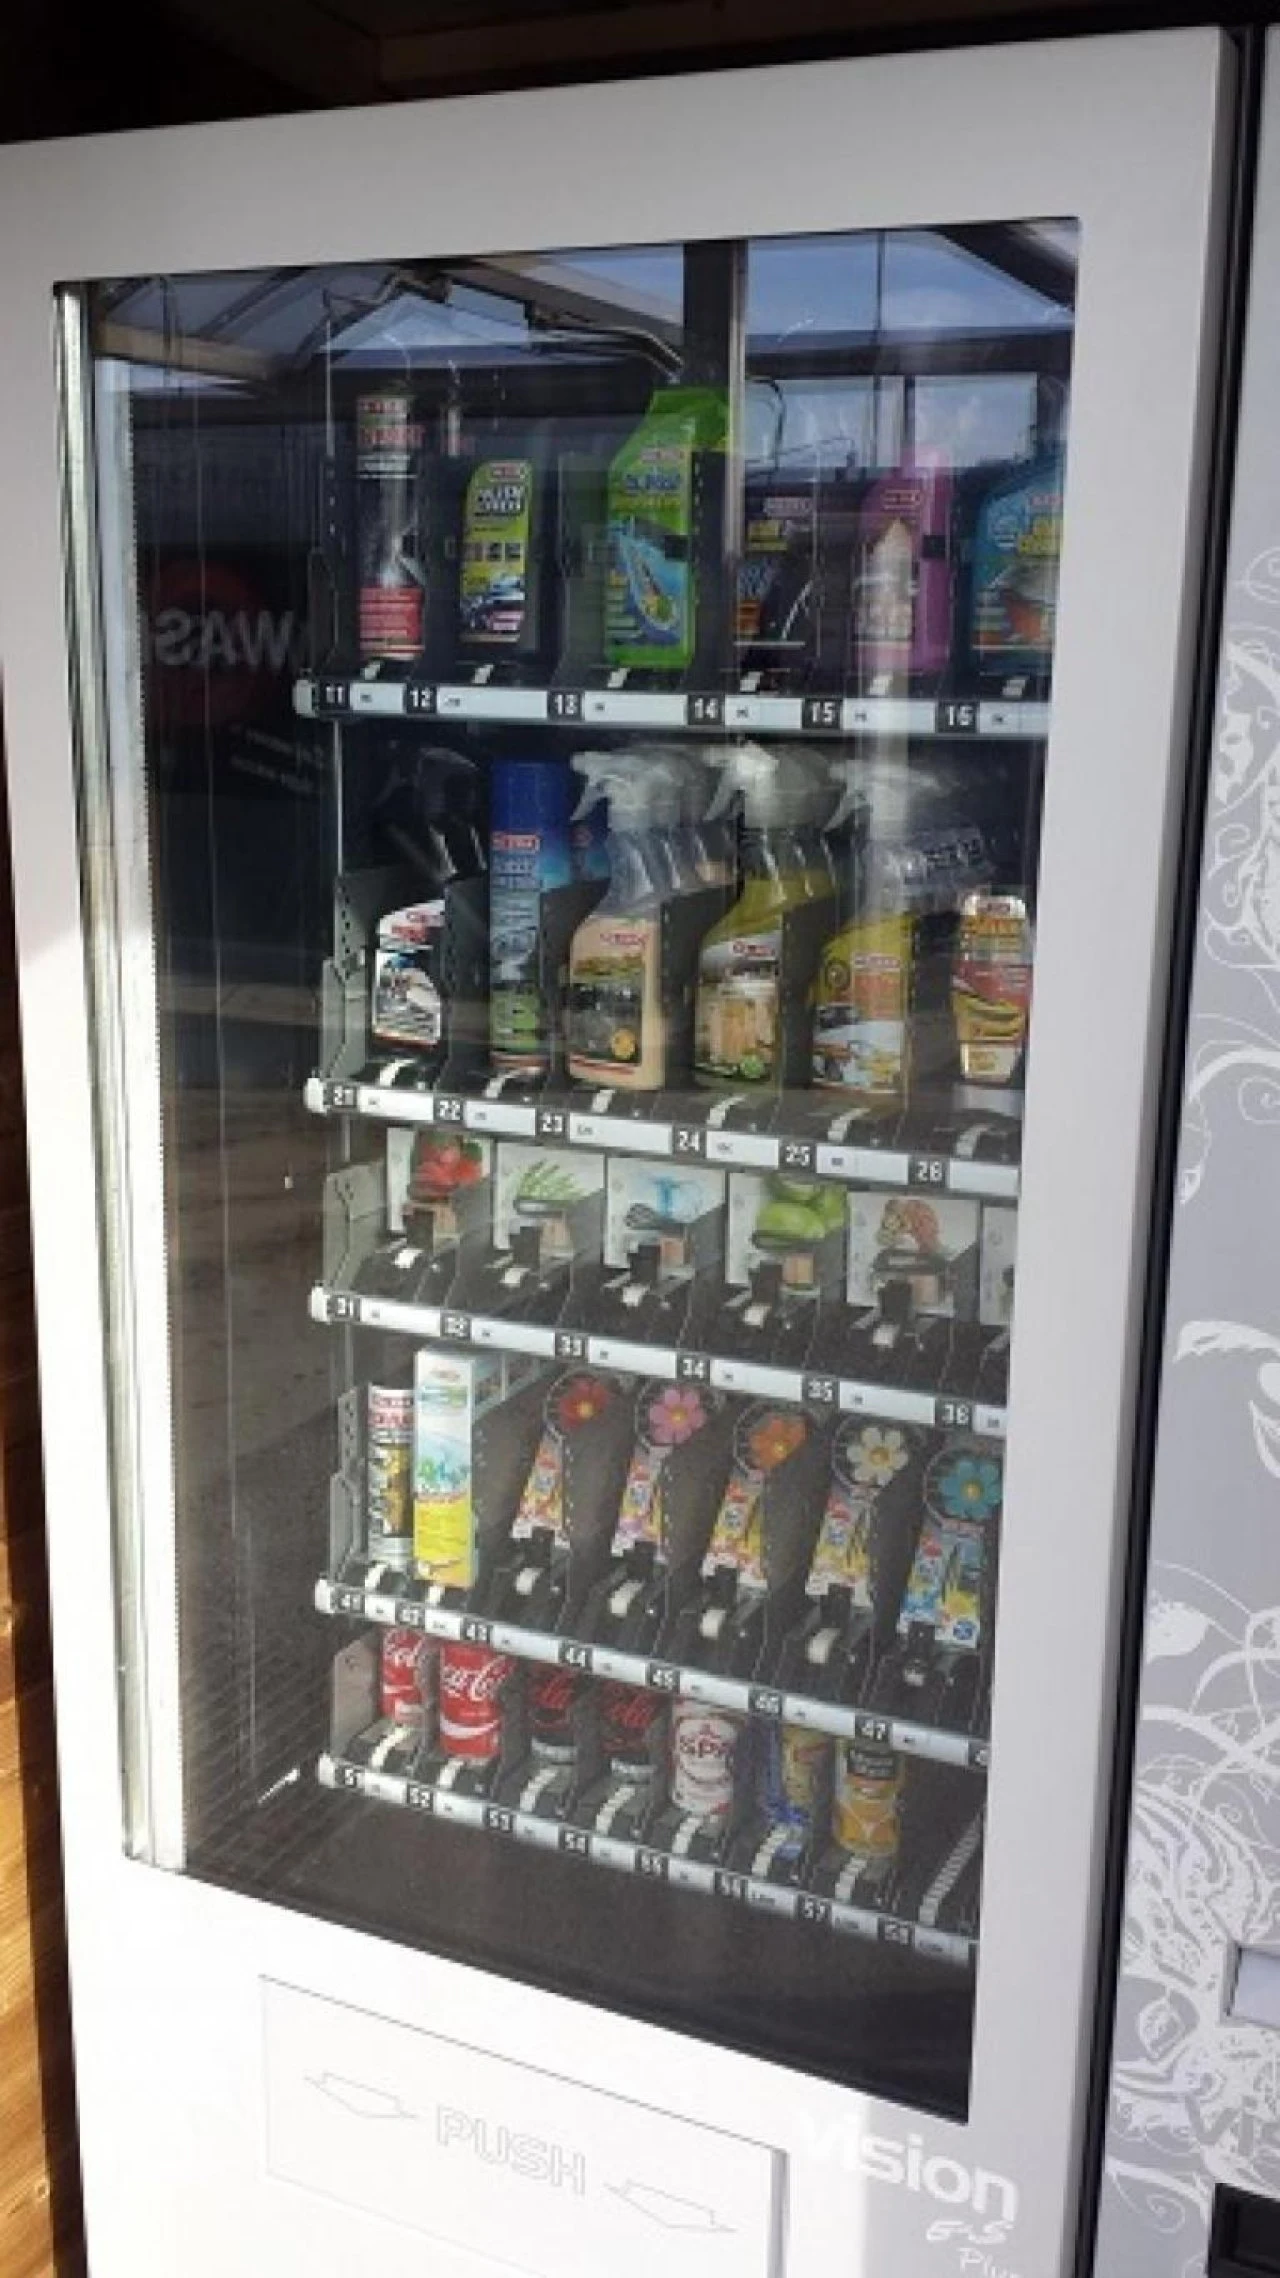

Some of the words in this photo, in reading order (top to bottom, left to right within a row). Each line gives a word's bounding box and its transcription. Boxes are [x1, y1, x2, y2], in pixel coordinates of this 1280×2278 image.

[325, 685, 344, 704] 11
[410, 687, 432, 708] 12
[694, 697, 718, 719] 14
[812, 701, 835, 723] 15
[679, 1131, 699, 1151] 24
[436, 2104, 586, 2196] PUSH
